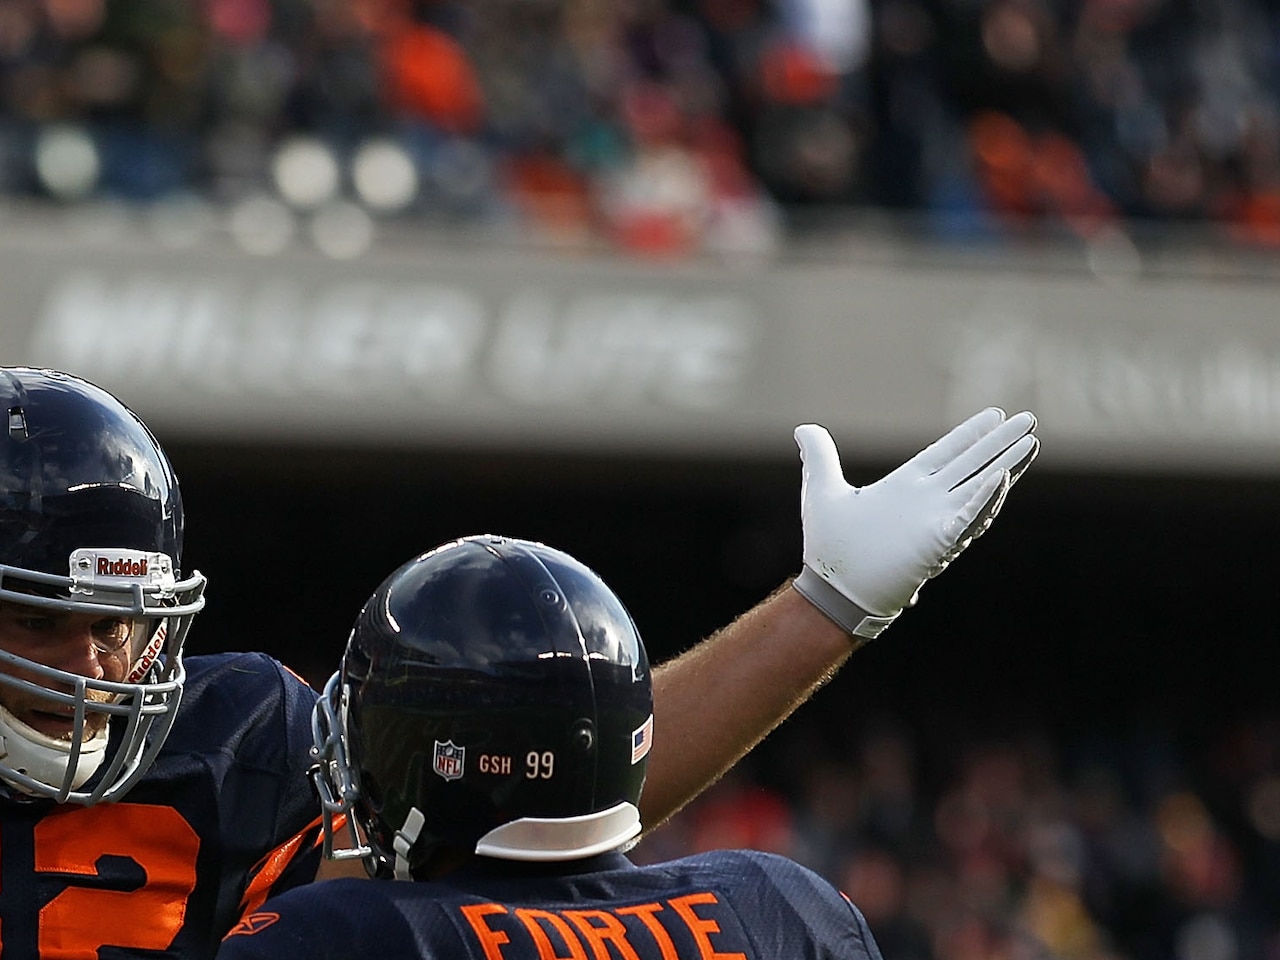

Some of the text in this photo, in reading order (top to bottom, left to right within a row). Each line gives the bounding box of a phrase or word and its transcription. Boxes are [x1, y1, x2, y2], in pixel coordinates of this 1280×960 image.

[96, 556, 148, 577] Riddell
[128, 626, 168, 684] Riddell
[436, 755, 460, 776] NFL
[479, 750, 555, 779] GSH 99
